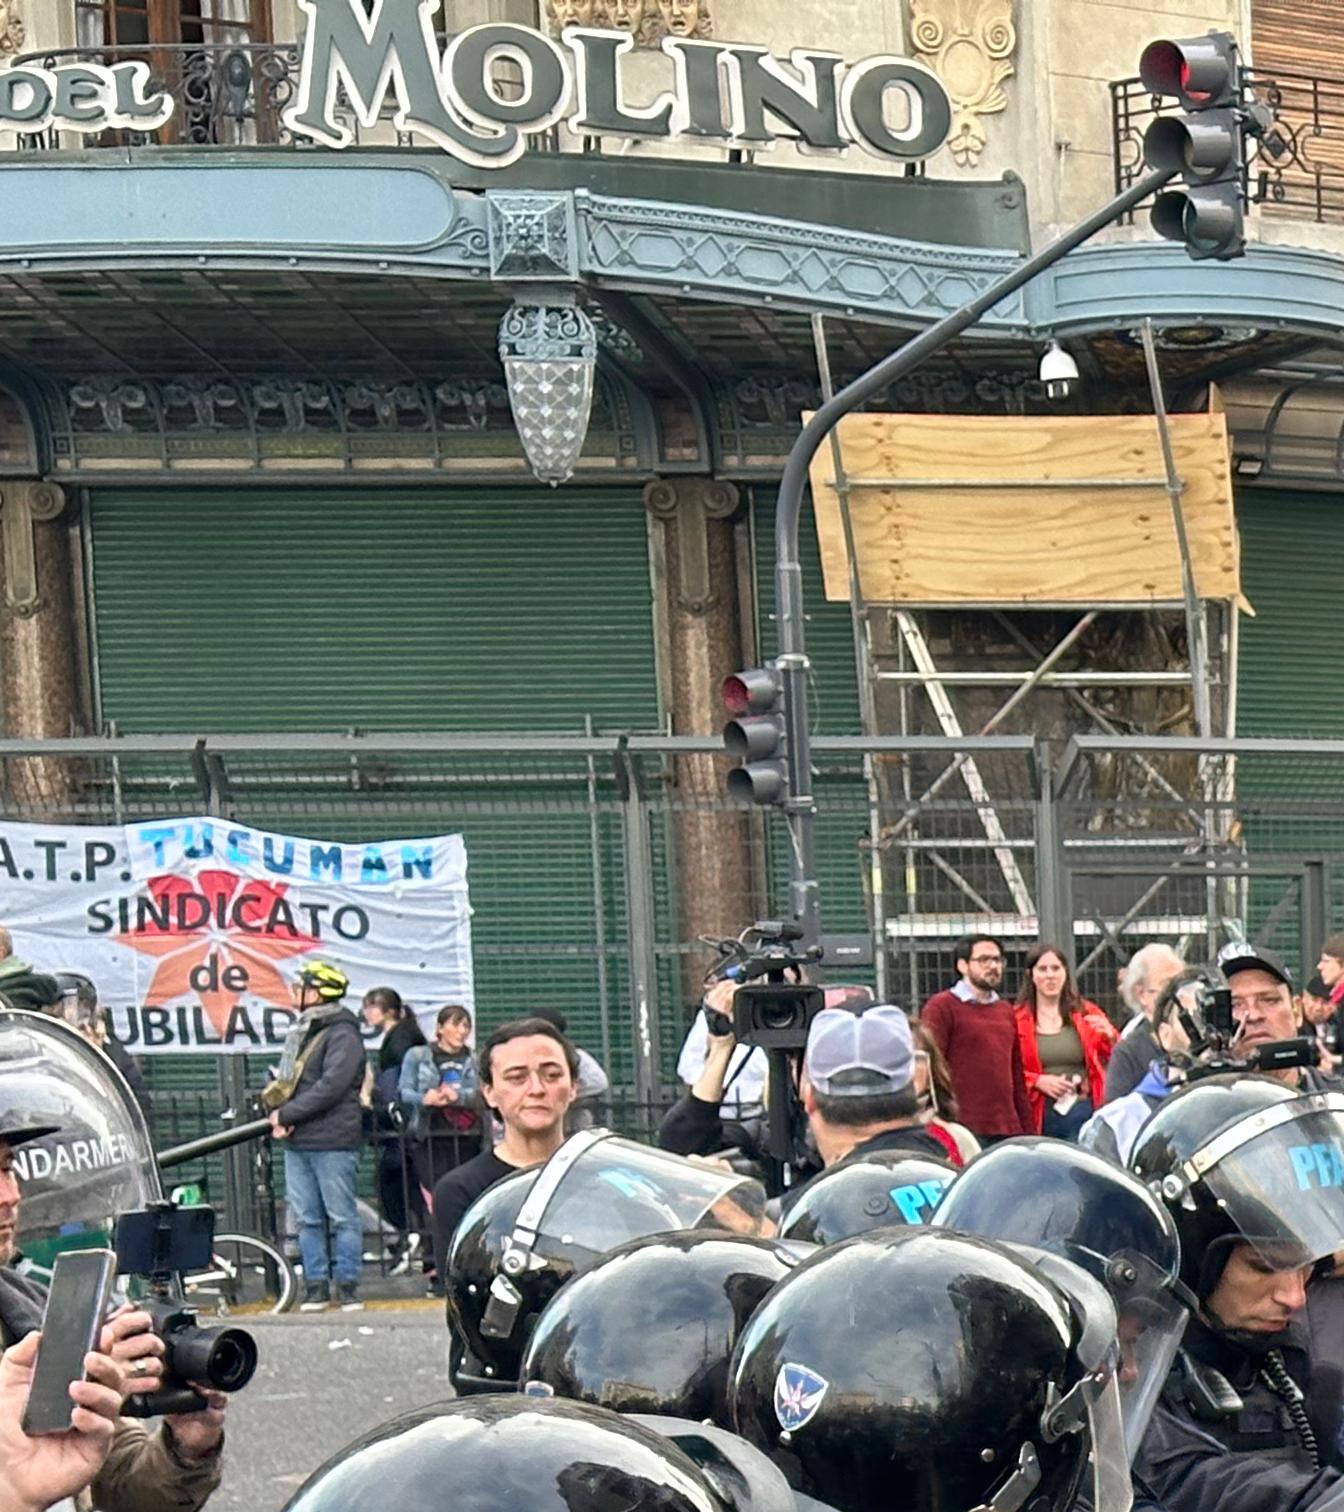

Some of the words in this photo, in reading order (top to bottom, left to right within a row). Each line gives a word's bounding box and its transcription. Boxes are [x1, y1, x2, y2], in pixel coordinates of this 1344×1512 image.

[1, 64, 170, 129] DEL
[286, 0, 952, 165] MOLINO
[138, 827, 435, 884] TUCUMAN
[87, 892, 370, 940] SINDICATO
[189, 953, 250, 992] de
[103, 1004, 299, 1047] UBILAD
[890, 1180, 945, 1225] PF
